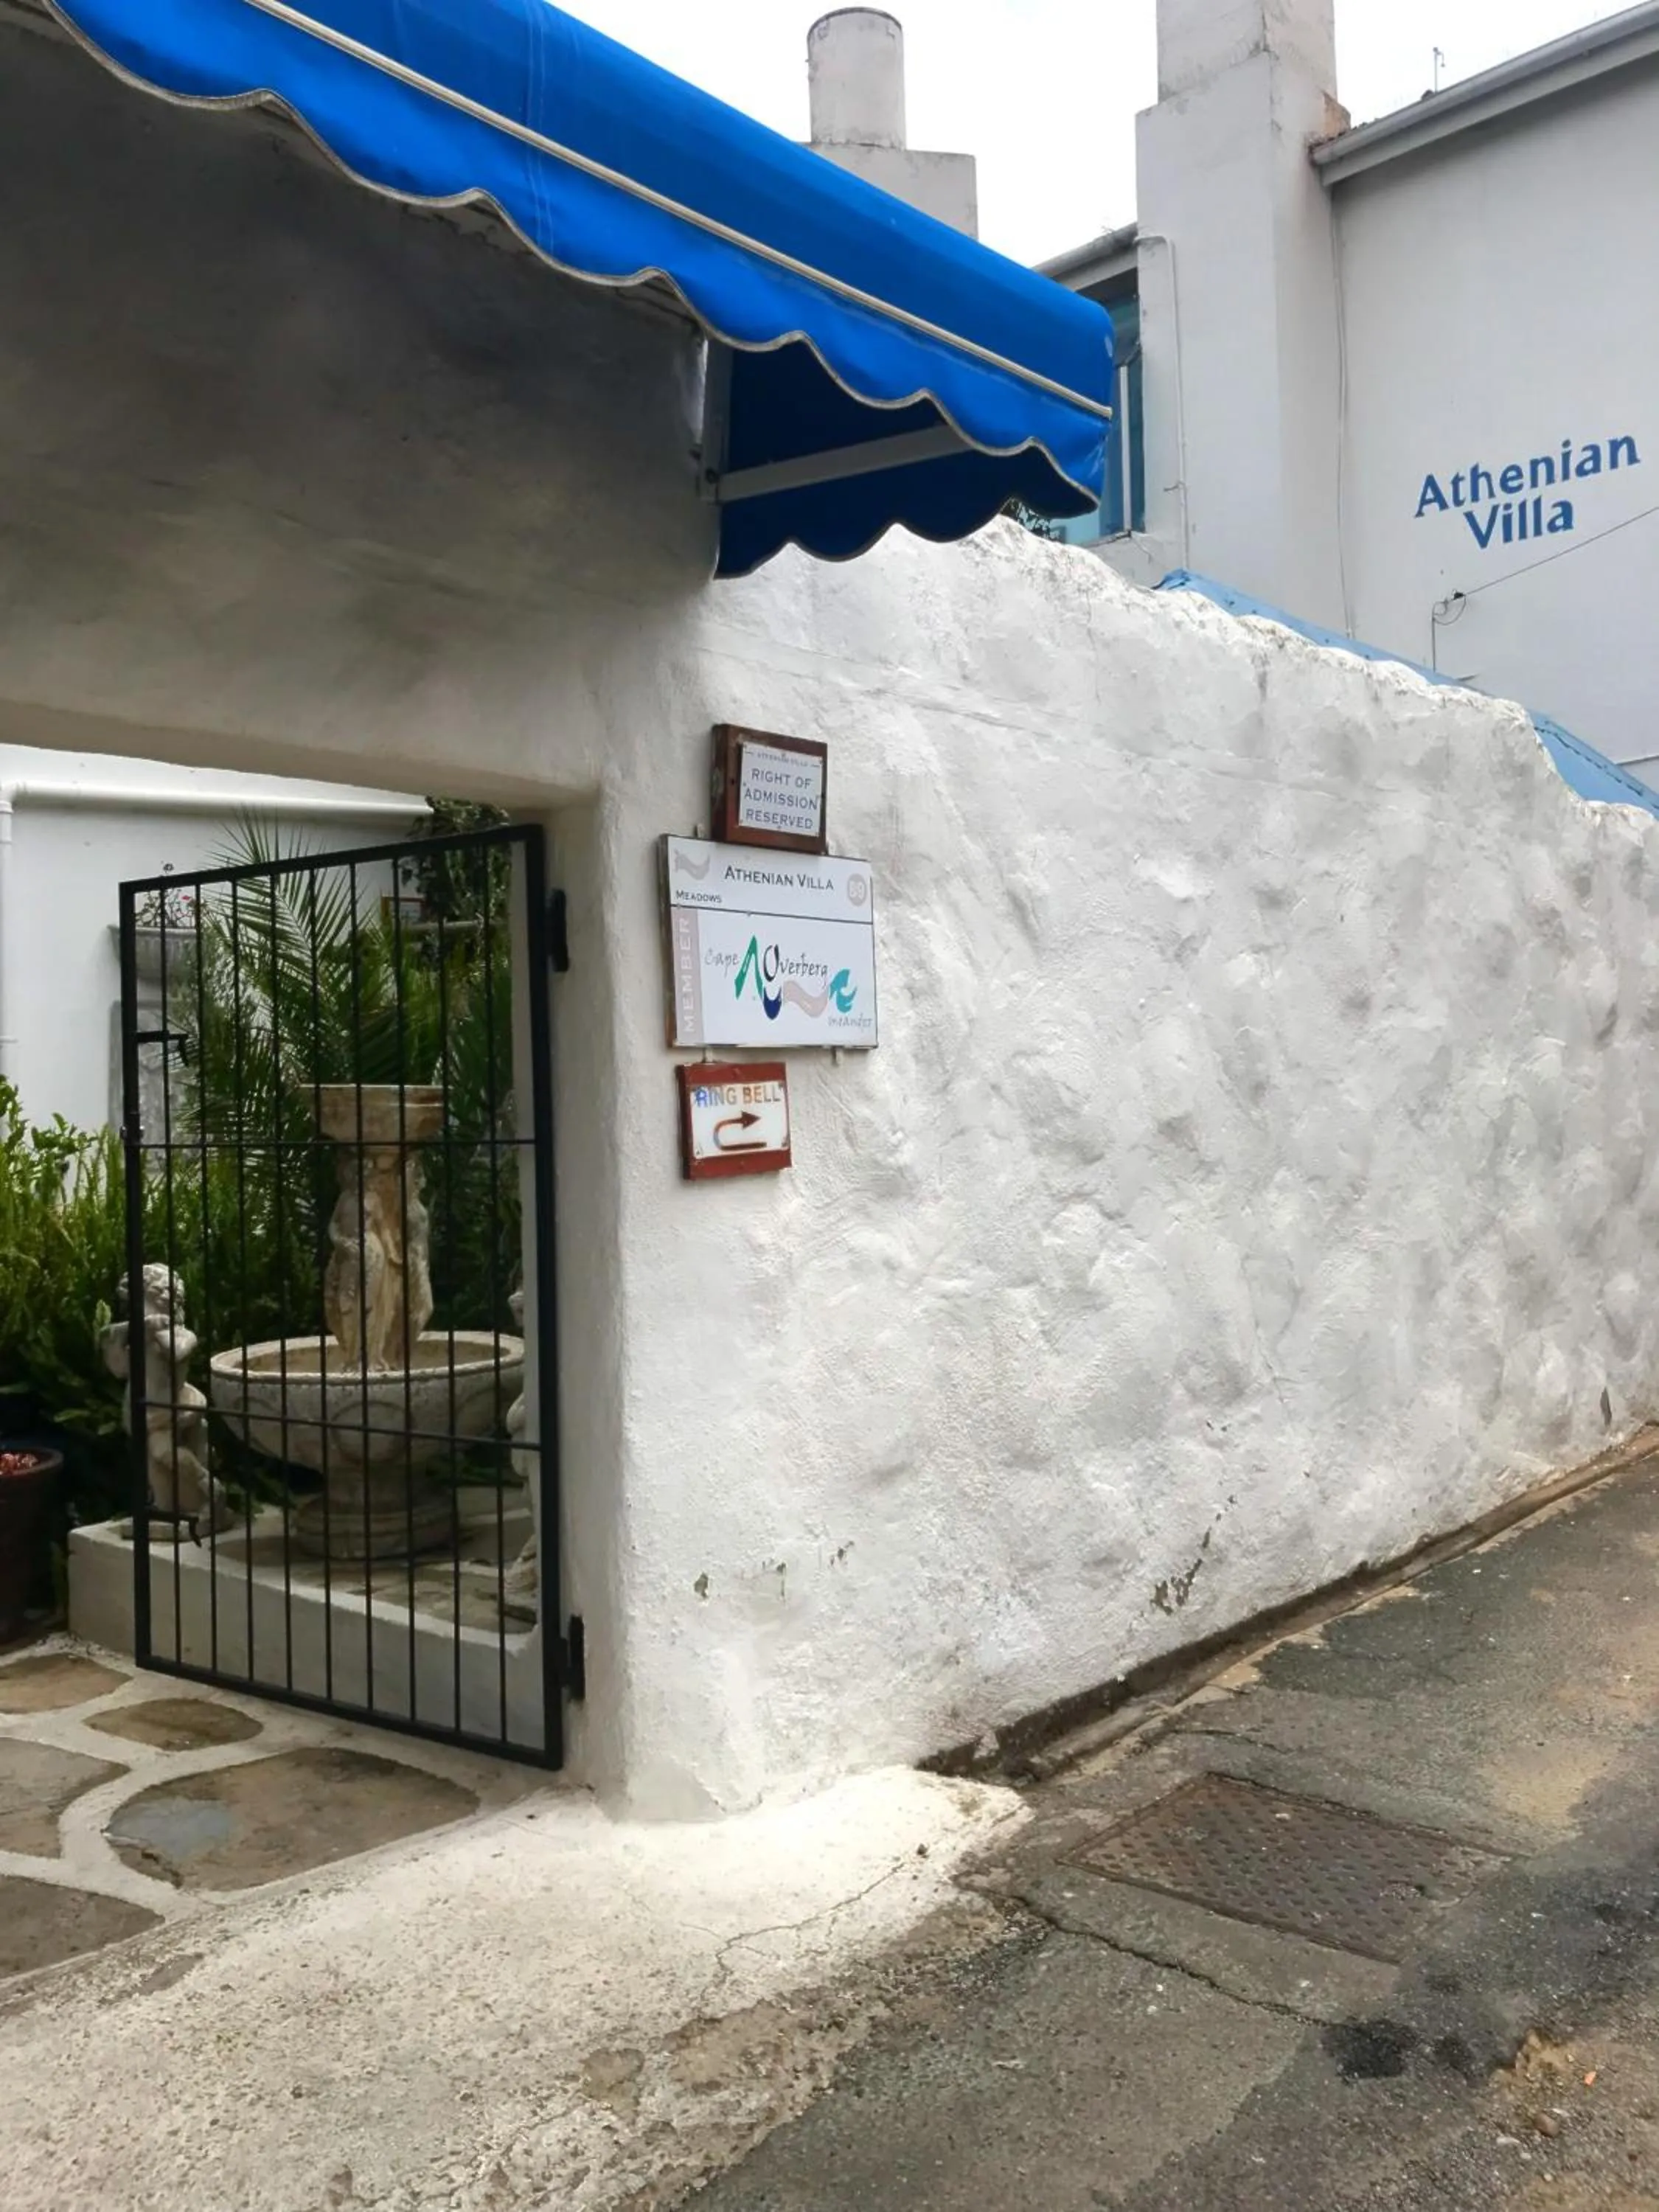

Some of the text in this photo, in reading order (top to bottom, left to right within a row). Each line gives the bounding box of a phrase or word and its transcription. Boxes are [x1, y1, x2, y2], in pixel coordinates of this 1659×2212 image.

[1415, 435, 1641, 518] Athenian
[1464, 495, 1573, 549] Villa
[751, 768, 812, 789] RIGHT OF
[744, 786, 818, 810] ADMISSION
[745, 808, 813, 829] RESERVED
[679, 919, 695, 1033] MEMBER
[704, 944, 828, 989] Cape Overberg
[695, 1084, 781, 1107] RING BELL
